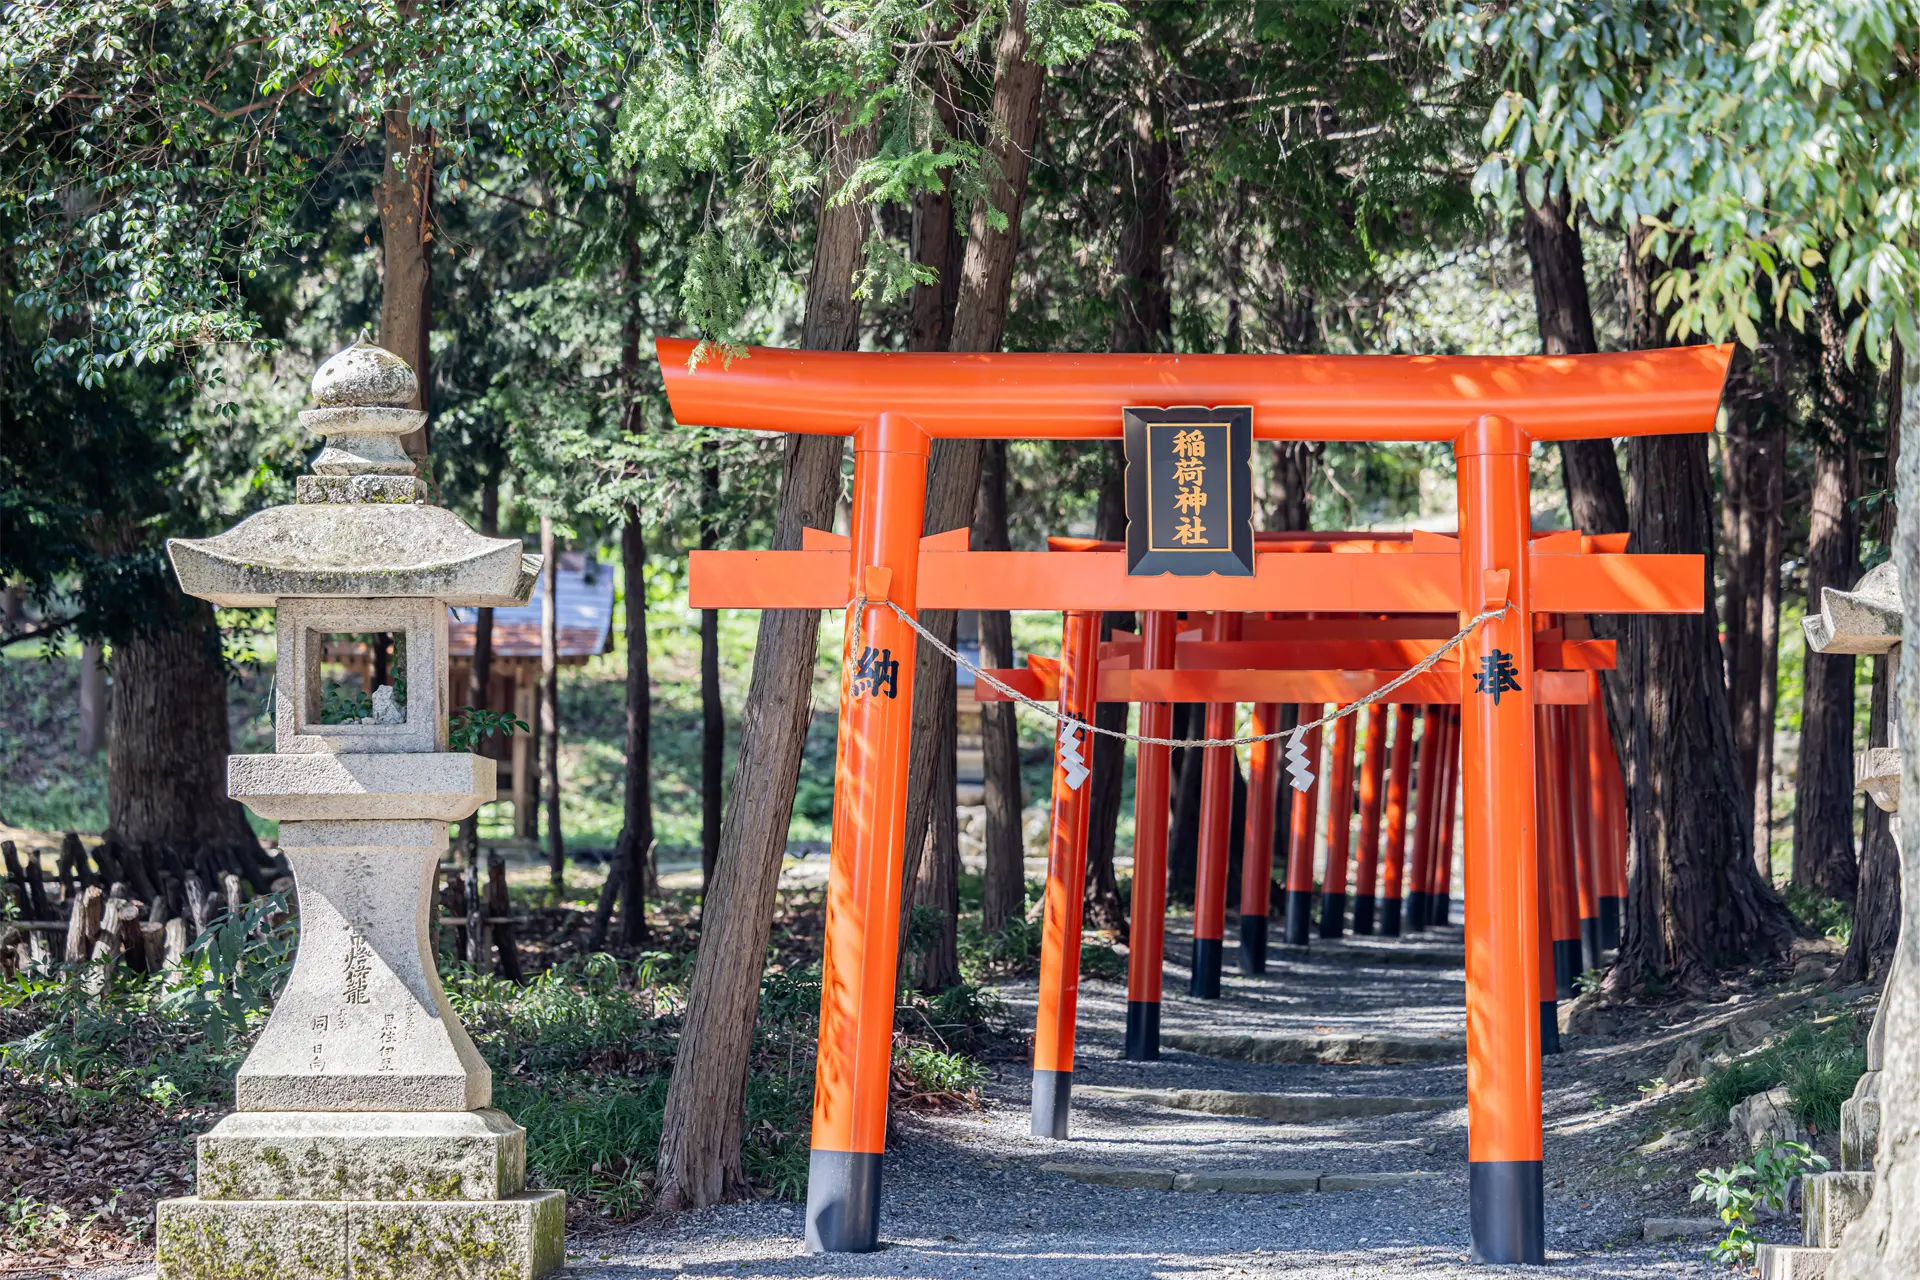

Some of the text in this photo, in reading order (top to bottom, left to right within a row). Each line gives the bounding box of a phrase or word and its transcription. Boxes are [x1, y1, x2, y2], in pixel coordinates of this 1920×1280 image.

[1172, 429, 1209, 545] 稲荷神社
[854, 646, 900, 699] 納
[1472, 648, 1523, 706] 奉
